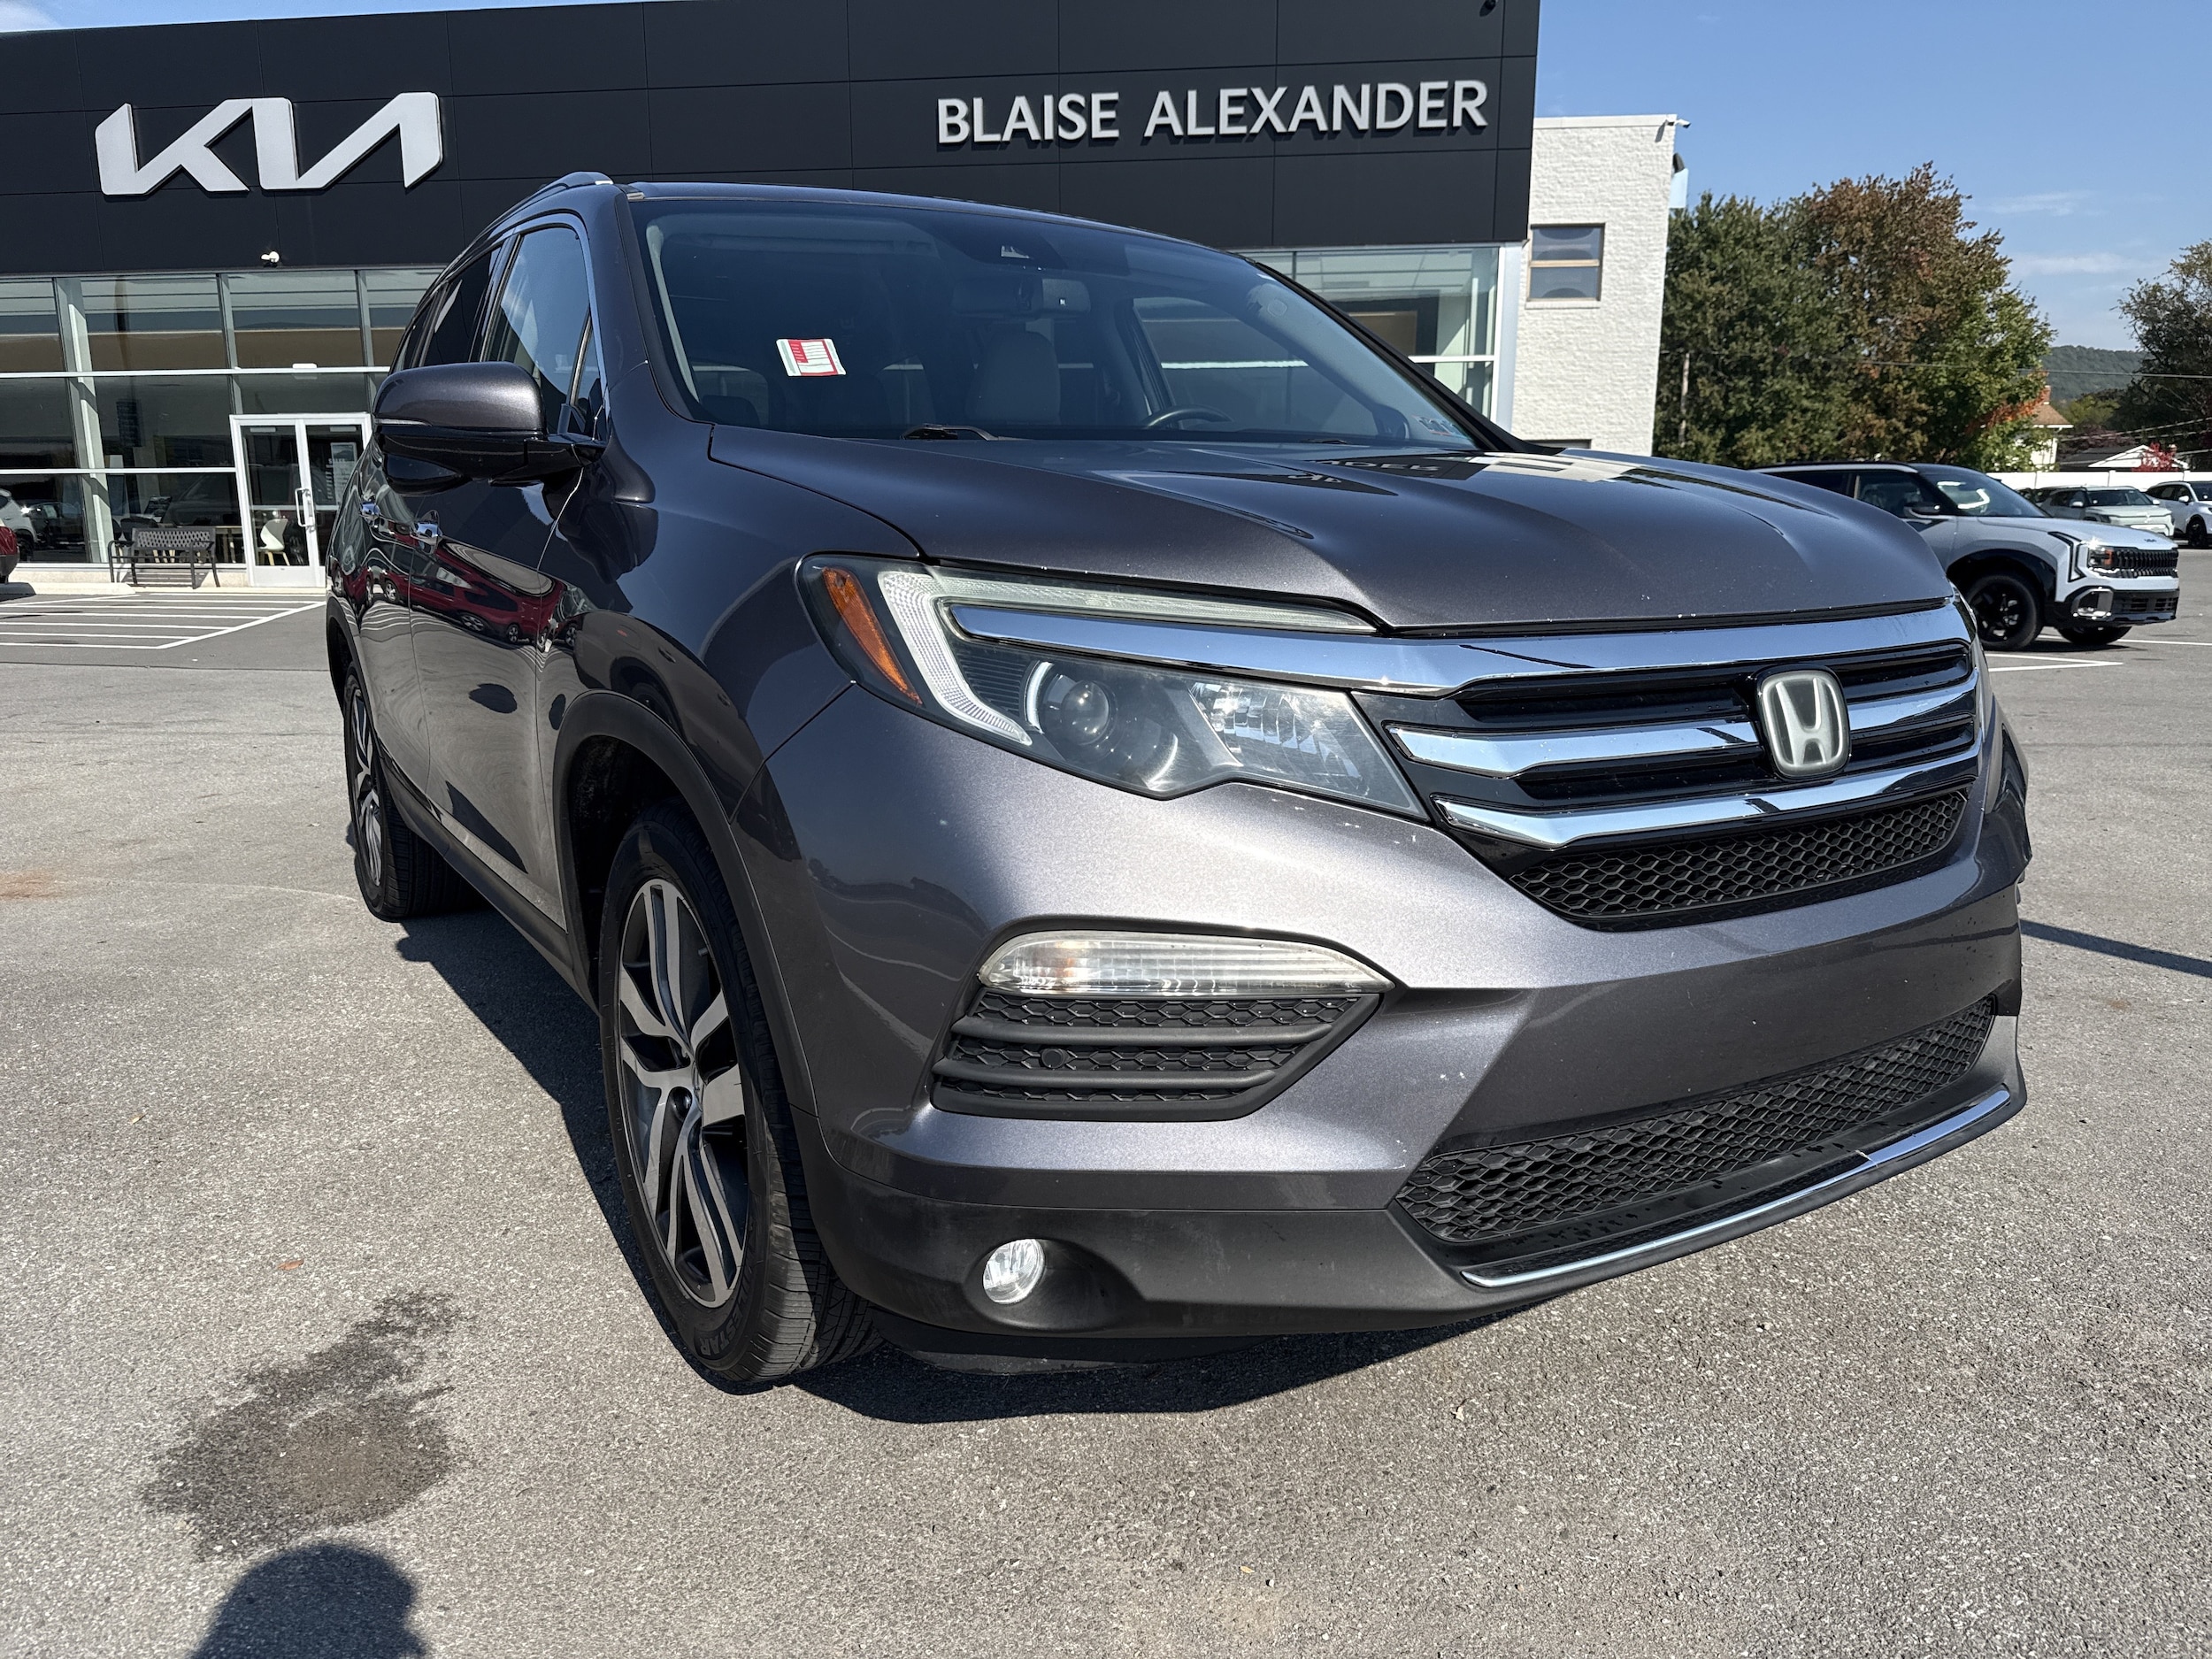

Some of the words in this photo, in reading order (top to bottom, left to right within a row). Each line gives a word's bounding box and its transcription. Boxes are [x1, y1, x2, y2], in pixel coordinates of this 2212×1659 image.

[95, 91, 443, 196] KIA
[937, 91, 1119, 144] BLAISE
[1143, 79, 1489, 138] ALEXANDER
